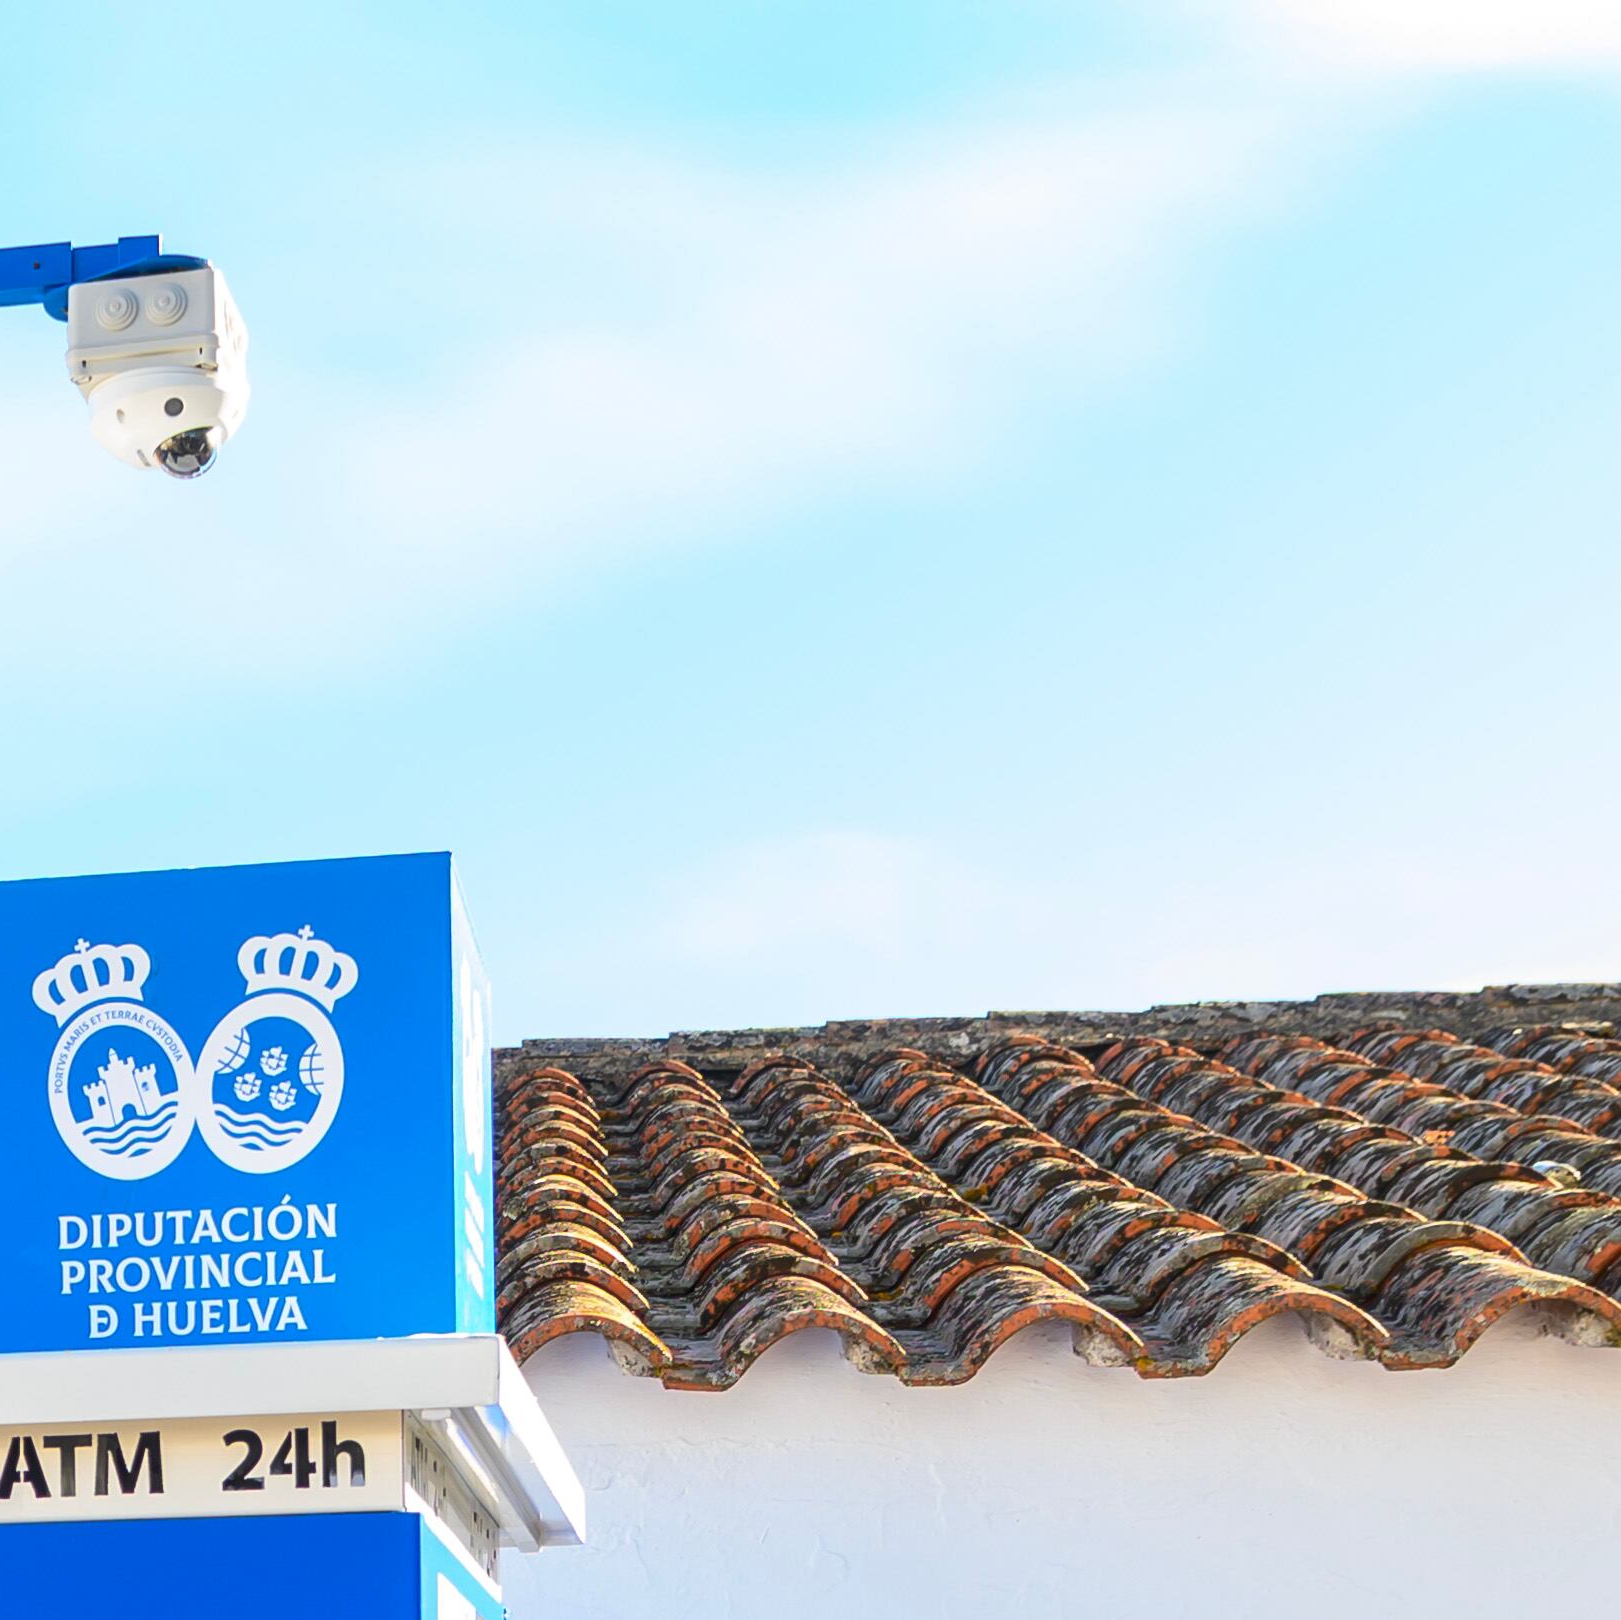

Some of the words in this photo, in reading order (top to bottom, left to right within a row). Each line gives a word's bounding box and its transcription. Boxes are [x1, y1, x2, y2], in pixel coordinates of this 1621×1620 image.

[54, 1053, 68, 1094] PORTVS
[64, 1022, 90, 1051] MARIS
[90, 1013, 103, 1026] ET
[104, 1010, 145, 1025] TERRAE
[145, 1018, 184, 1062] CVSTODIA
[58, 1194, 337, 1251] DIPUTACIÓN
[60, 1248, 336, 1295] PROVINCIAL
[133, 1296, 308, 1337] HUELVA
[222, 1420, 366, 1491] 24h
